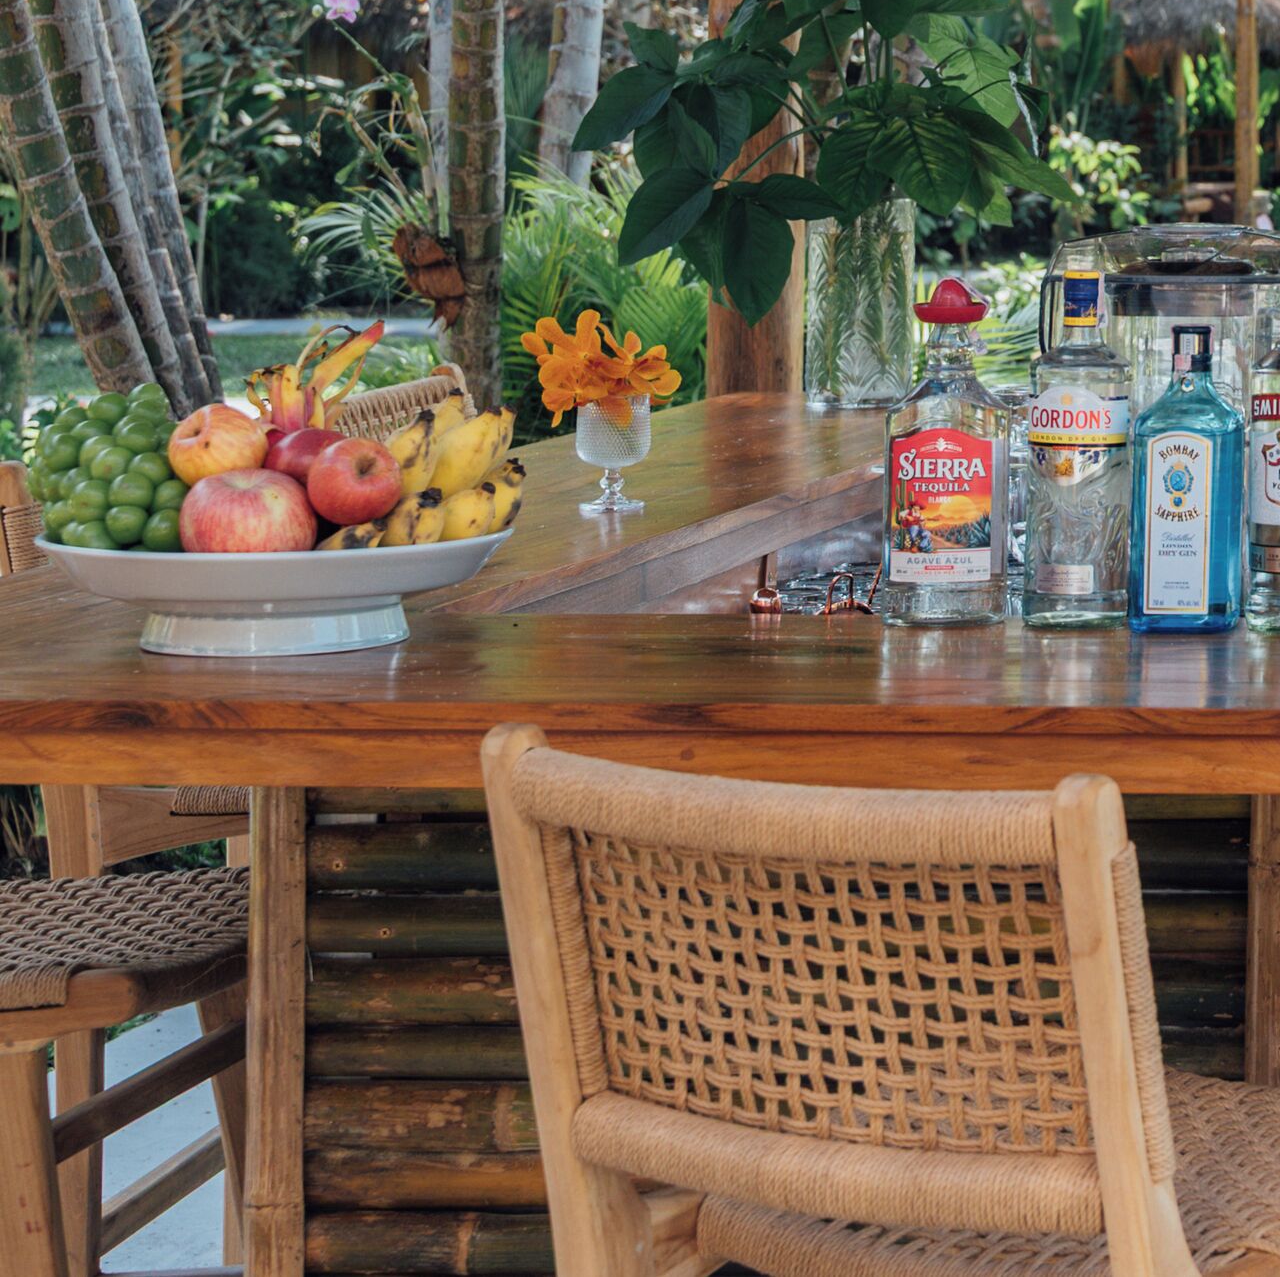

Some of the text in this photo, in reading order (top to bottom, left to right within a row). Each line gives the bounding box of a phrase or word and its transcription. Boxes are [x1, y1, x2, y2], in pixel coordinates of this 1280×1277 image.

[1158, 444, 1200, 463] BOMBAY
[898, 449, 987, 481] SIERRA
[913, 482, 971, 493] TEQUILA
[1154, 504, 1201, 522] SAPPHIRE
[907, 556, 973, 565] AGAVE AZUL
